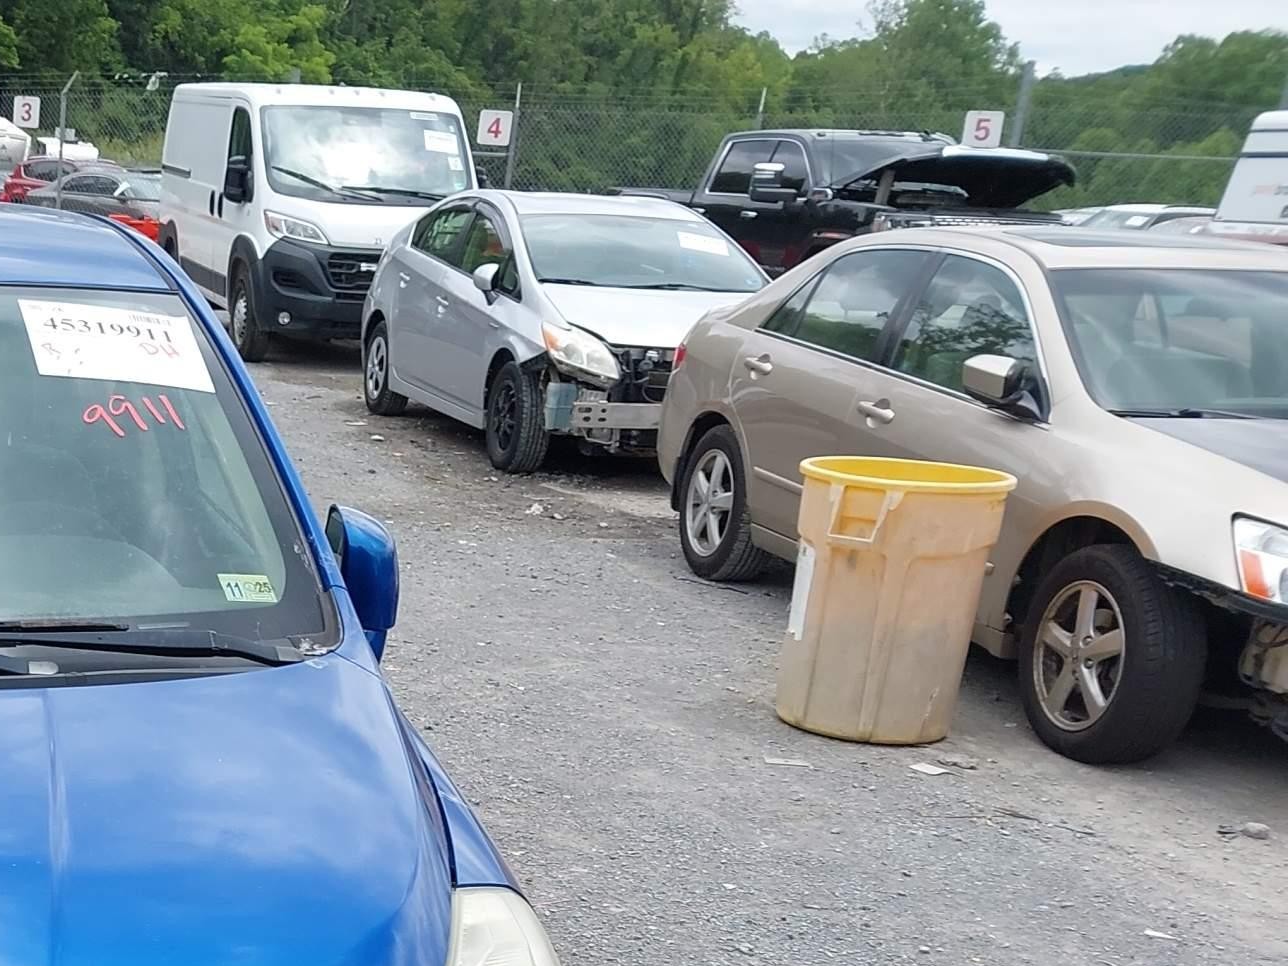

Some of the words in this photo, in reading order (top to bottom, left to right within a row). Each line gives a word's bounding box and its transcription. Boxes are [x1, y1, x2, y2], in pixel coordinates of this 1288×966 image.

[21, 102, 32, 122] 3
[486, 117, 502, 139] 4
[973, 117, 991, 142] 5
[43, 316, 173, 343] 45319911
[82, 393, 185, 438] 9911
[226, 582, 244, 598] 11
[256, 581, 273, 593] 25
